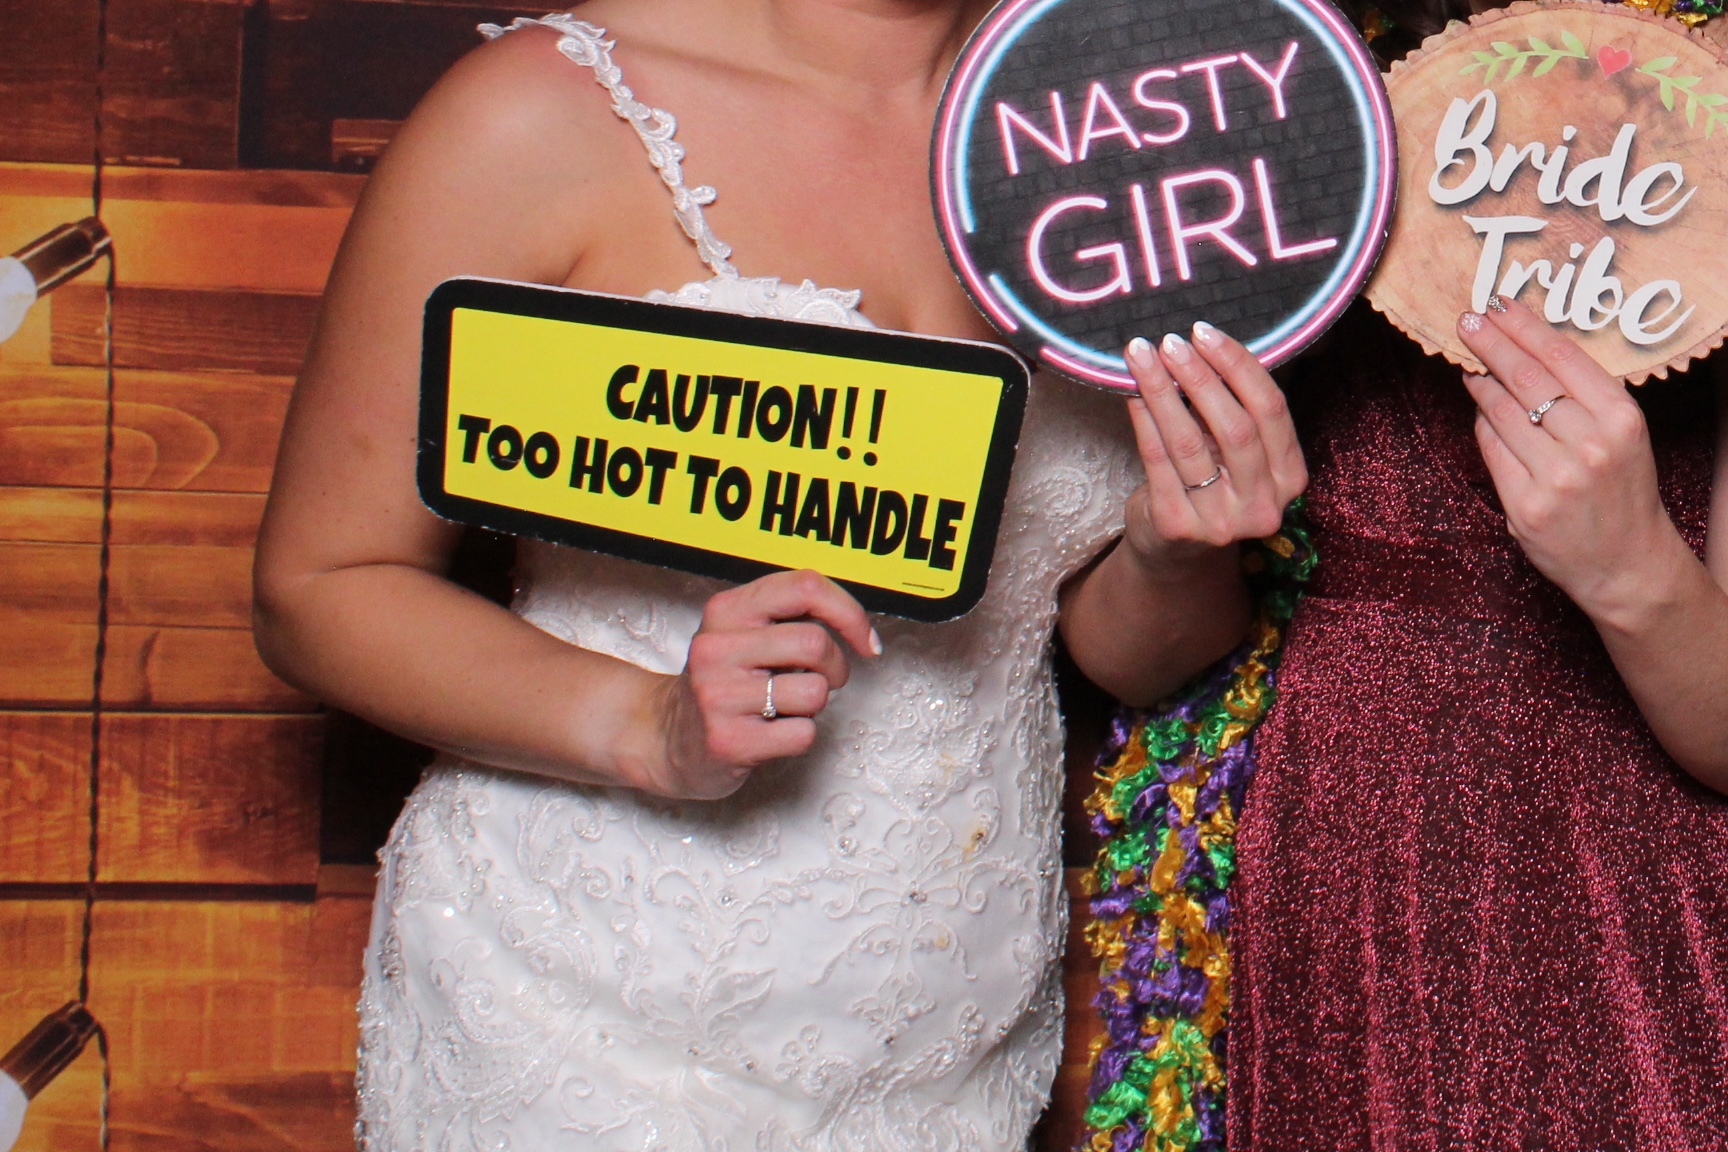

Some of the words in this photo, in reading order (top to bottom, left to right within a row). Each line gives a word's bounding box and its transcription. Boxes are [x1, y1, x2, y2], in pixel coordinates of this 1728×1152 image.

[996, 40, 1299, 176] NASTY
[1428, 88, 1698, 227] Bride
[1028, 157, 1338, 303] GIRL
[1461, 214, 1697, 346] Tribe
[606, 364, 887, 467] CAUTION!!
[457, 413, 560, 480] TOO
[568, 434, 678, 506] HOT
[686, 454, 752, 522] TO
[759, 471, 966, 571] HANDLE
